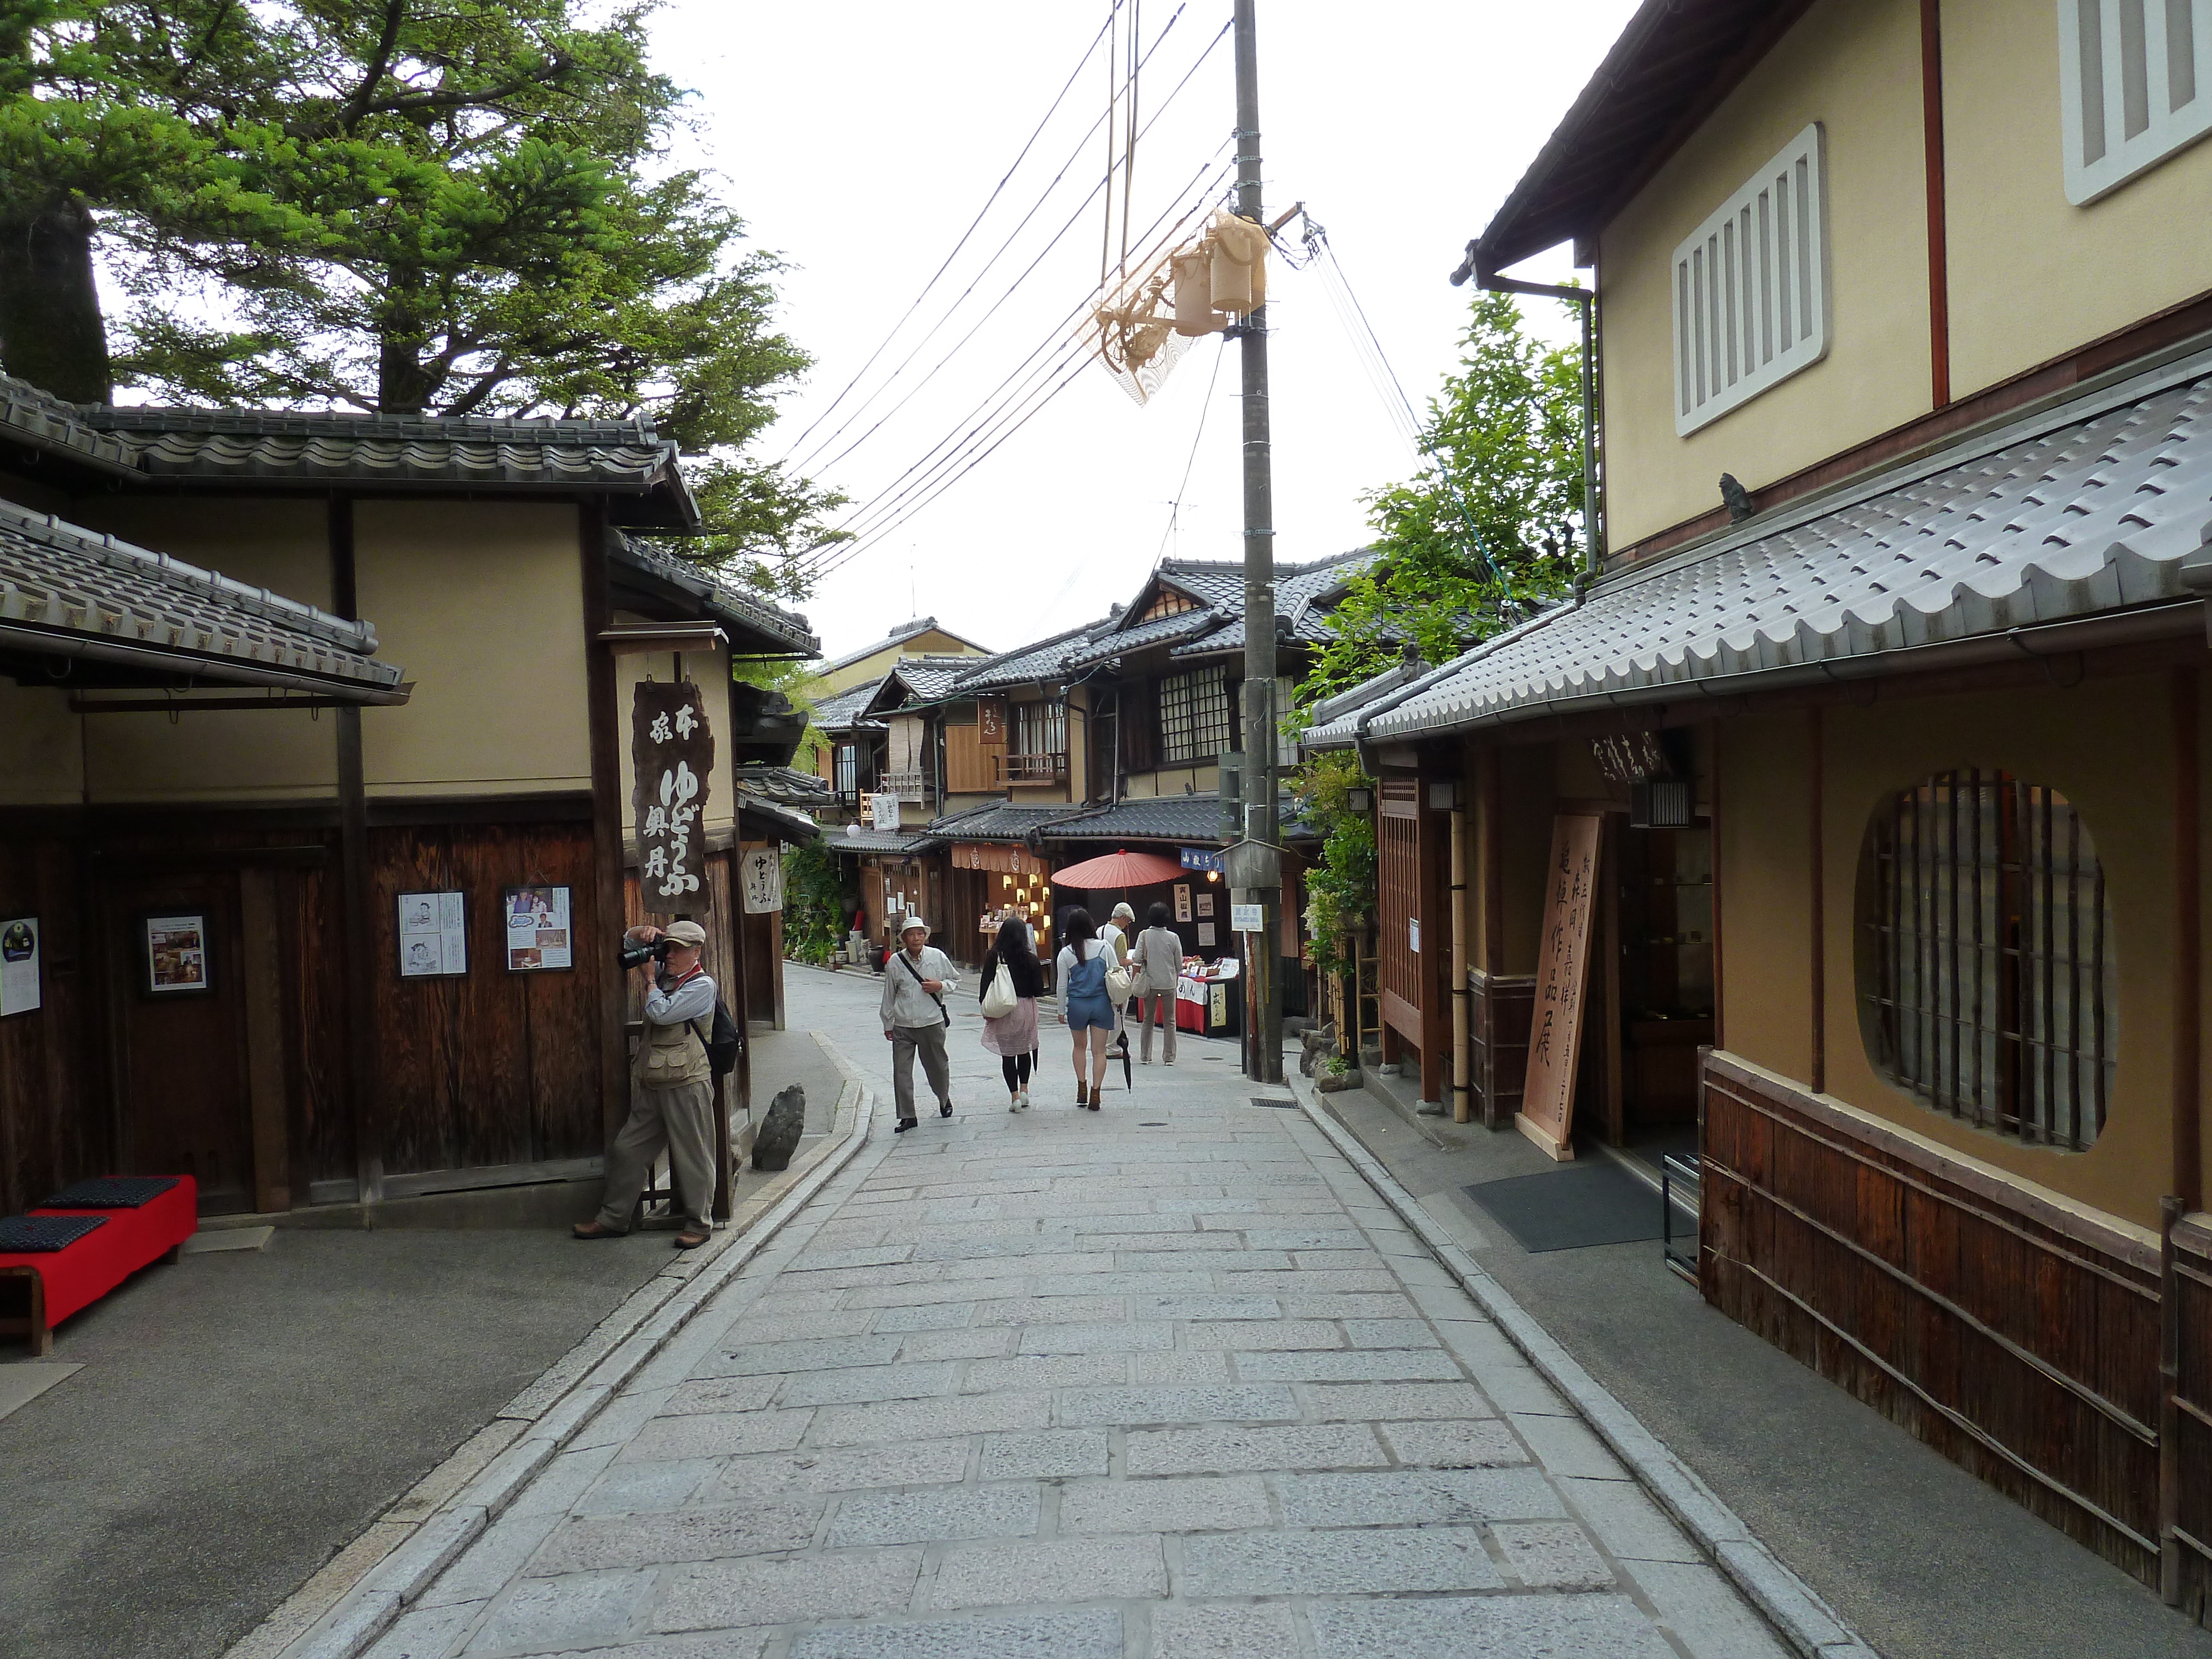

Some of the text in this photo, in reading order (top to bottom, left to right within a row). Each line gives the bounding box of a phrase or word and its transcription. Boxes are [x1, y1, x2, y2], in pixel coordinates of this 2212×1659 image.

[643, 805, 670, 878] 奥丹
[659, 760, 700, 896] ゆどうふ
